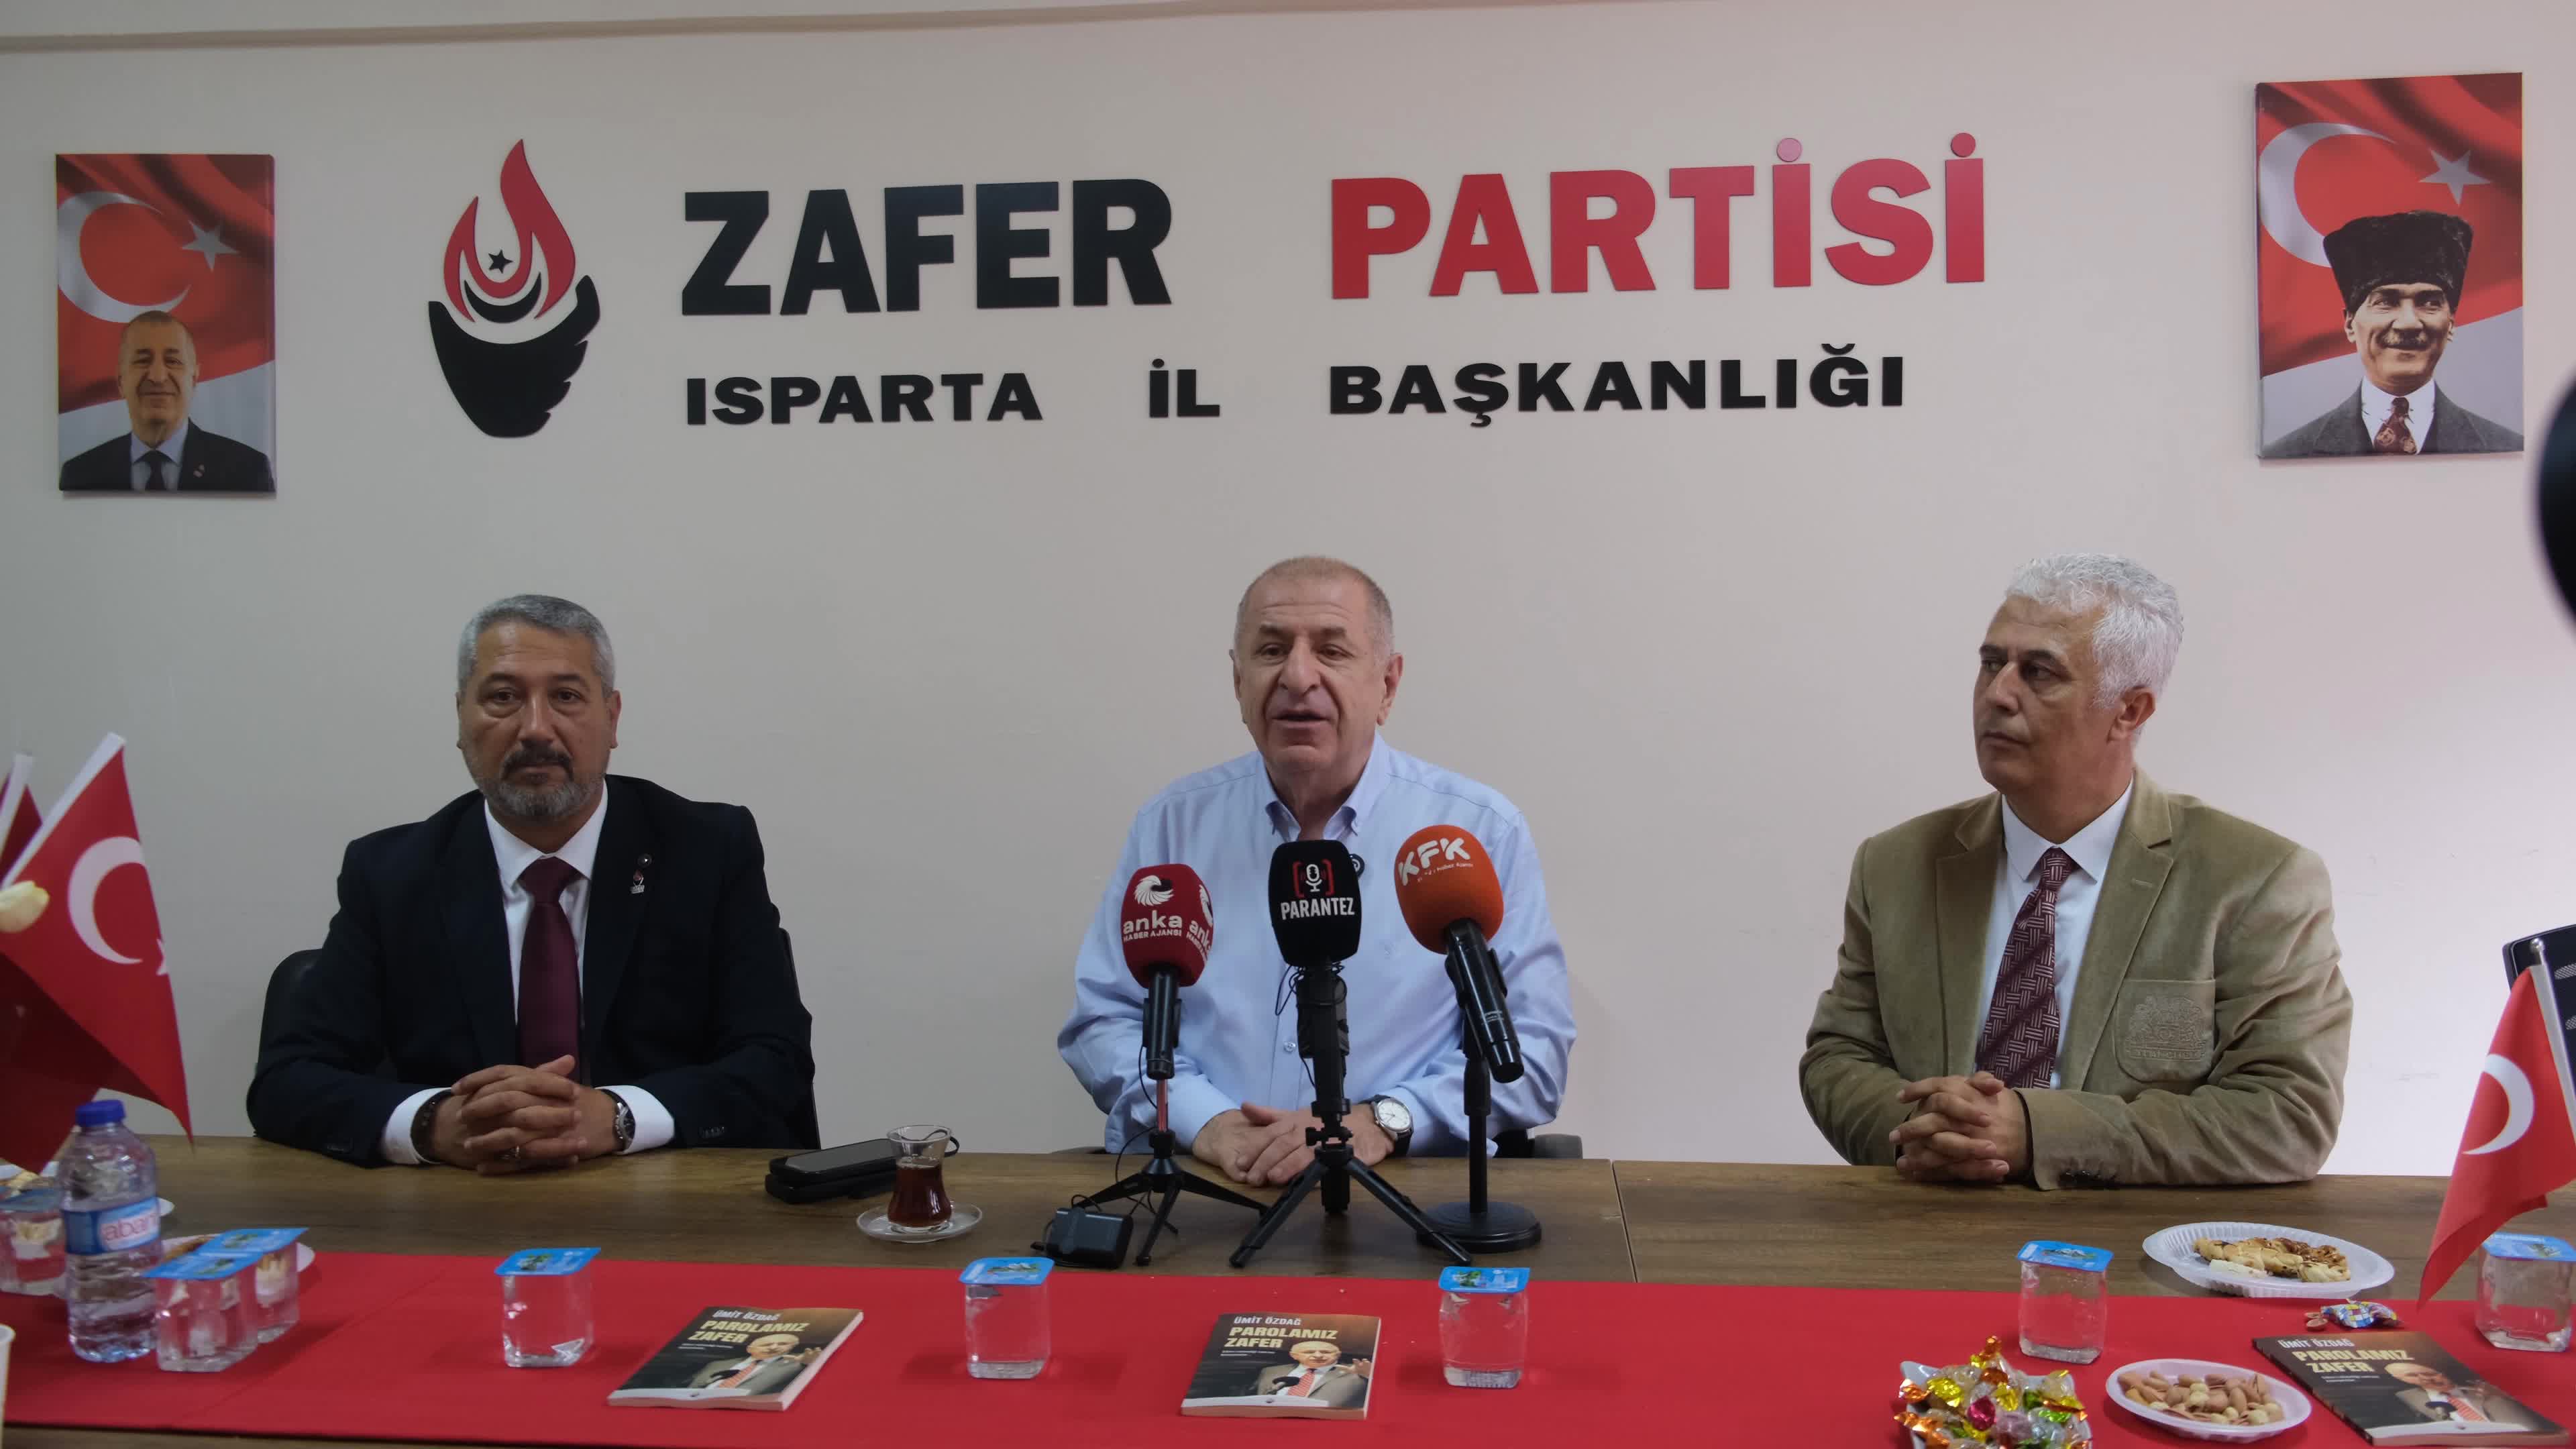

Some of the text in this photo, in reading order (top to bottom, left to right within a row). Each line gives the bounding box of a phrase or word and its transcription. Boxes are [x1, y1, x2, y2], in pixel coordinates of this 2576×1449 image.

[682, 133, 1984, 316] ZAFER PARTİSİ
[686, 343, 1904, 427] ISPARTA İL BAŞKANLIĞI
[1398, 838, 1470, 886] KFK
[1280, 897, 1355, 920] PARANTEZ
[1123, 910, 1183, 934] anka
[1123, 931, 1149, 943] HABER
[700, 1320, 810, 1333] PAROLAMIZ
[1234, 1316, 1303, 1326] ÜMİT ÖZDAĞ
[688, 1330, 750, 1344] ZAFER
[1229, 1326, 1338, 1340] PAROLAMIZ
[1224, 1338, 1283, 1349] ZAFER
[2292, 1349, 2415, 1361] PAROLAMIZ
[2306, 1361, 2375, 1373] ZAFER
